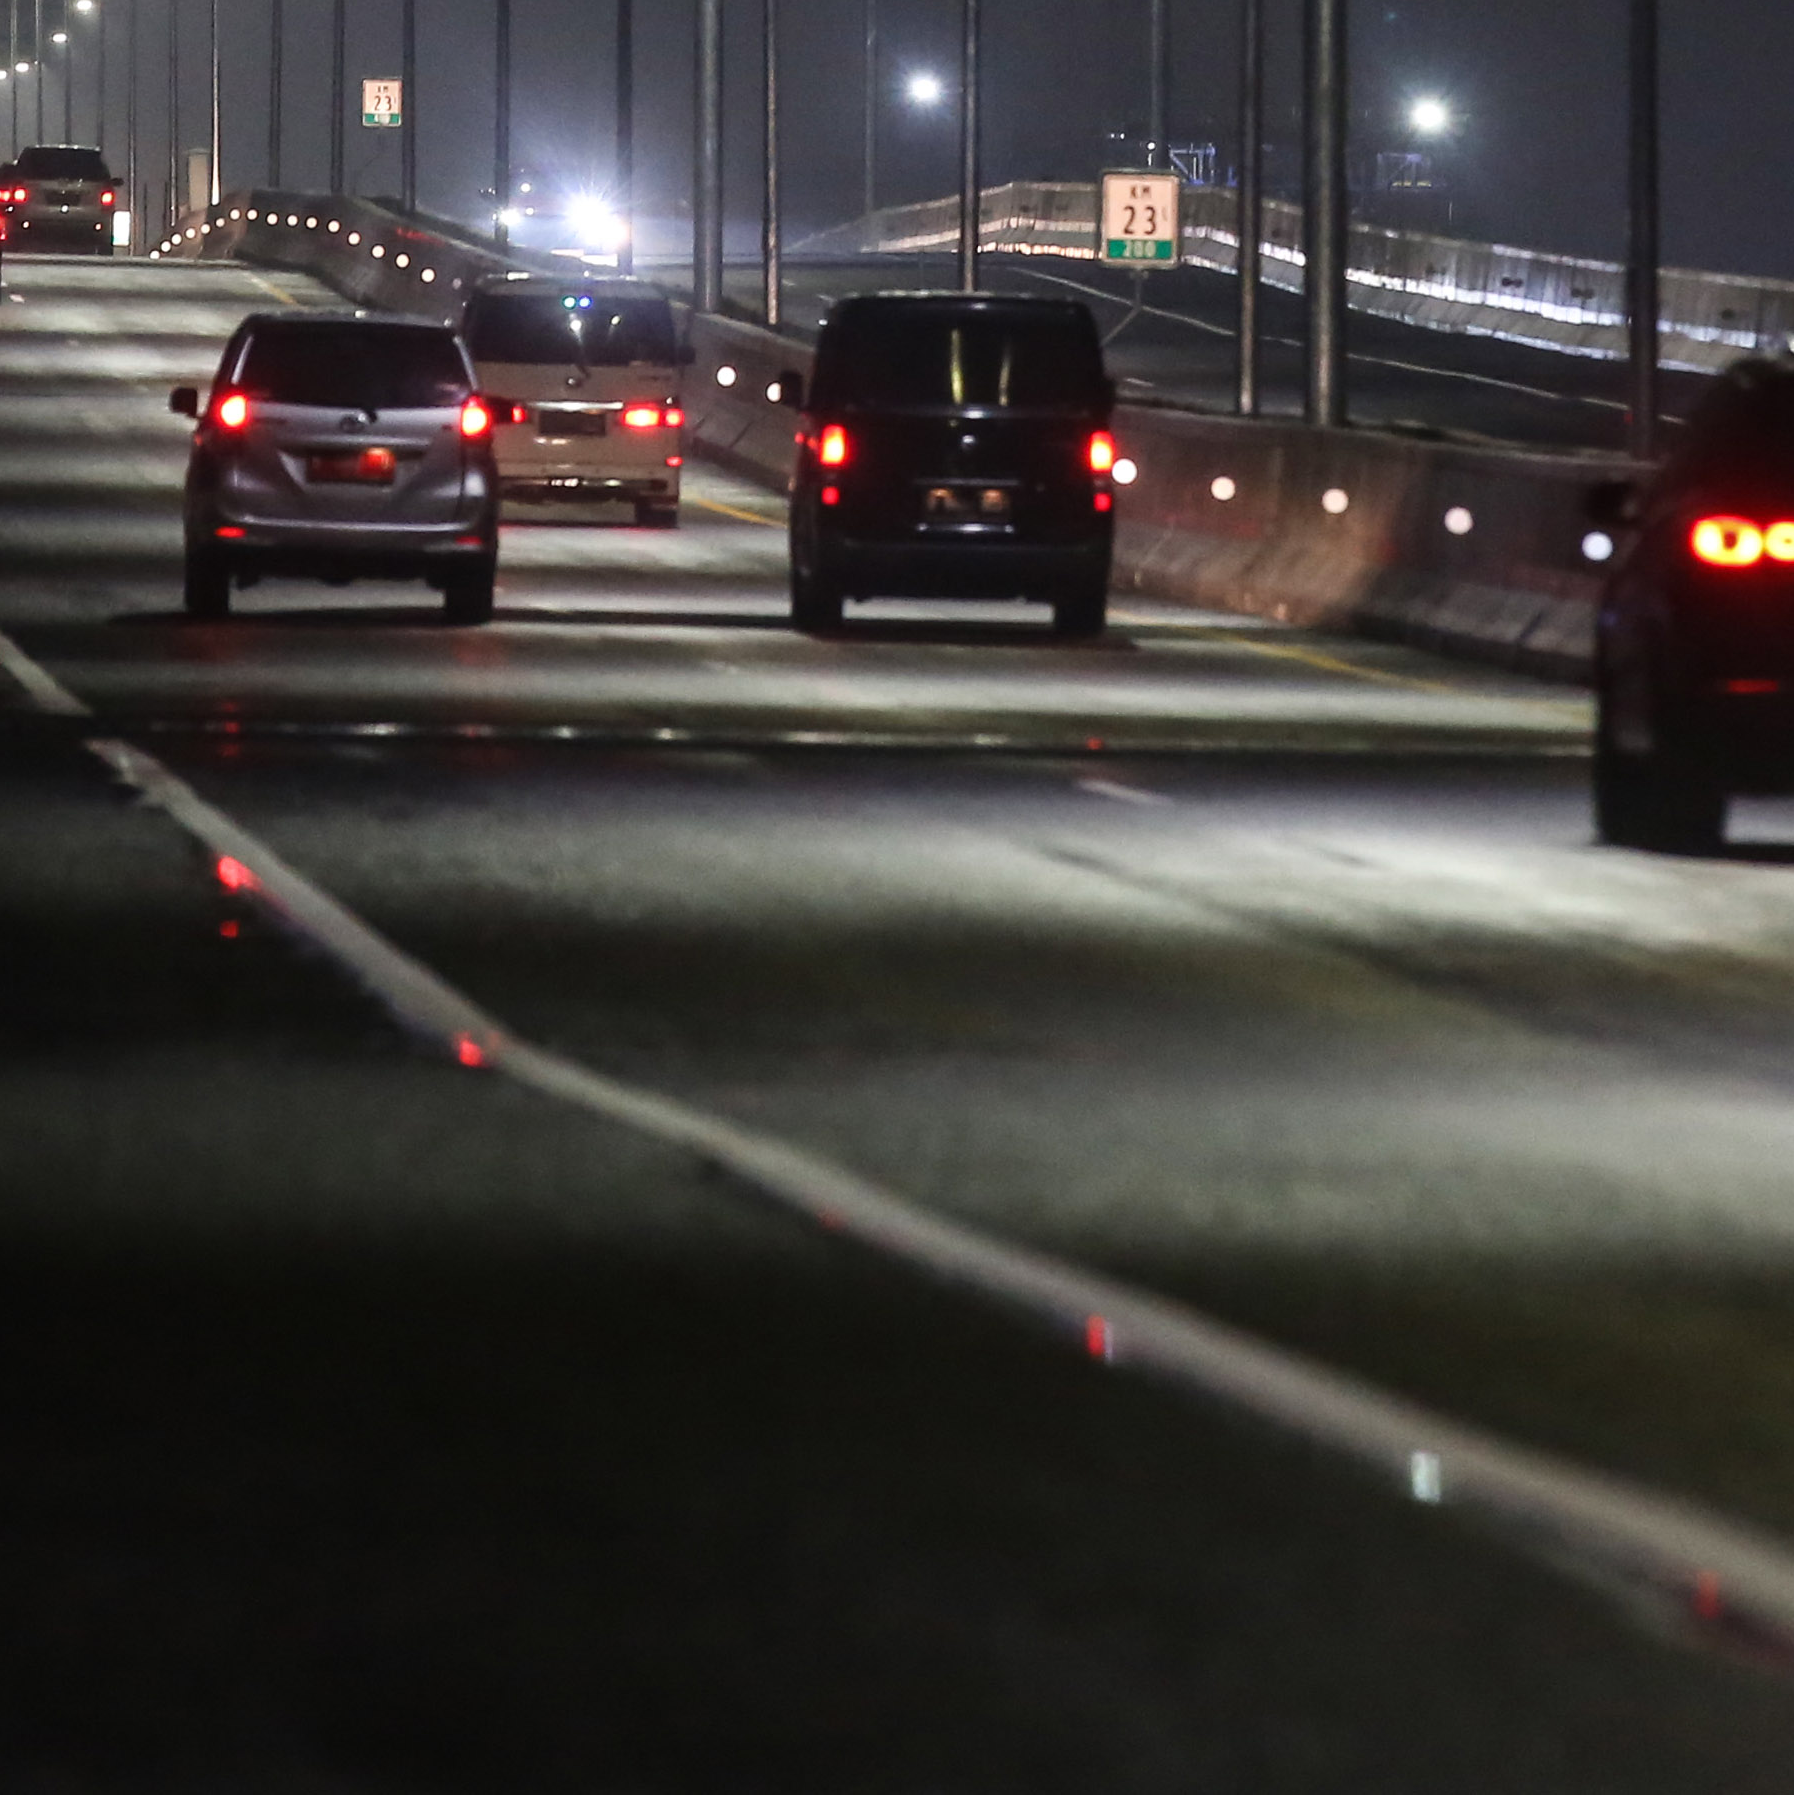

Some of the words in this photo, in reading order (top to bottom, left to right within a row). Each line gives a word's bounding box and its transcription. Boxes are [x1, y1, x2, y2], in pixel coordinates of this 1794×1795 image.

[374, 95, 392, 111] 23
[1130, 186, 1151, 199] KM
[1124, 206, 1156, 235] 23
